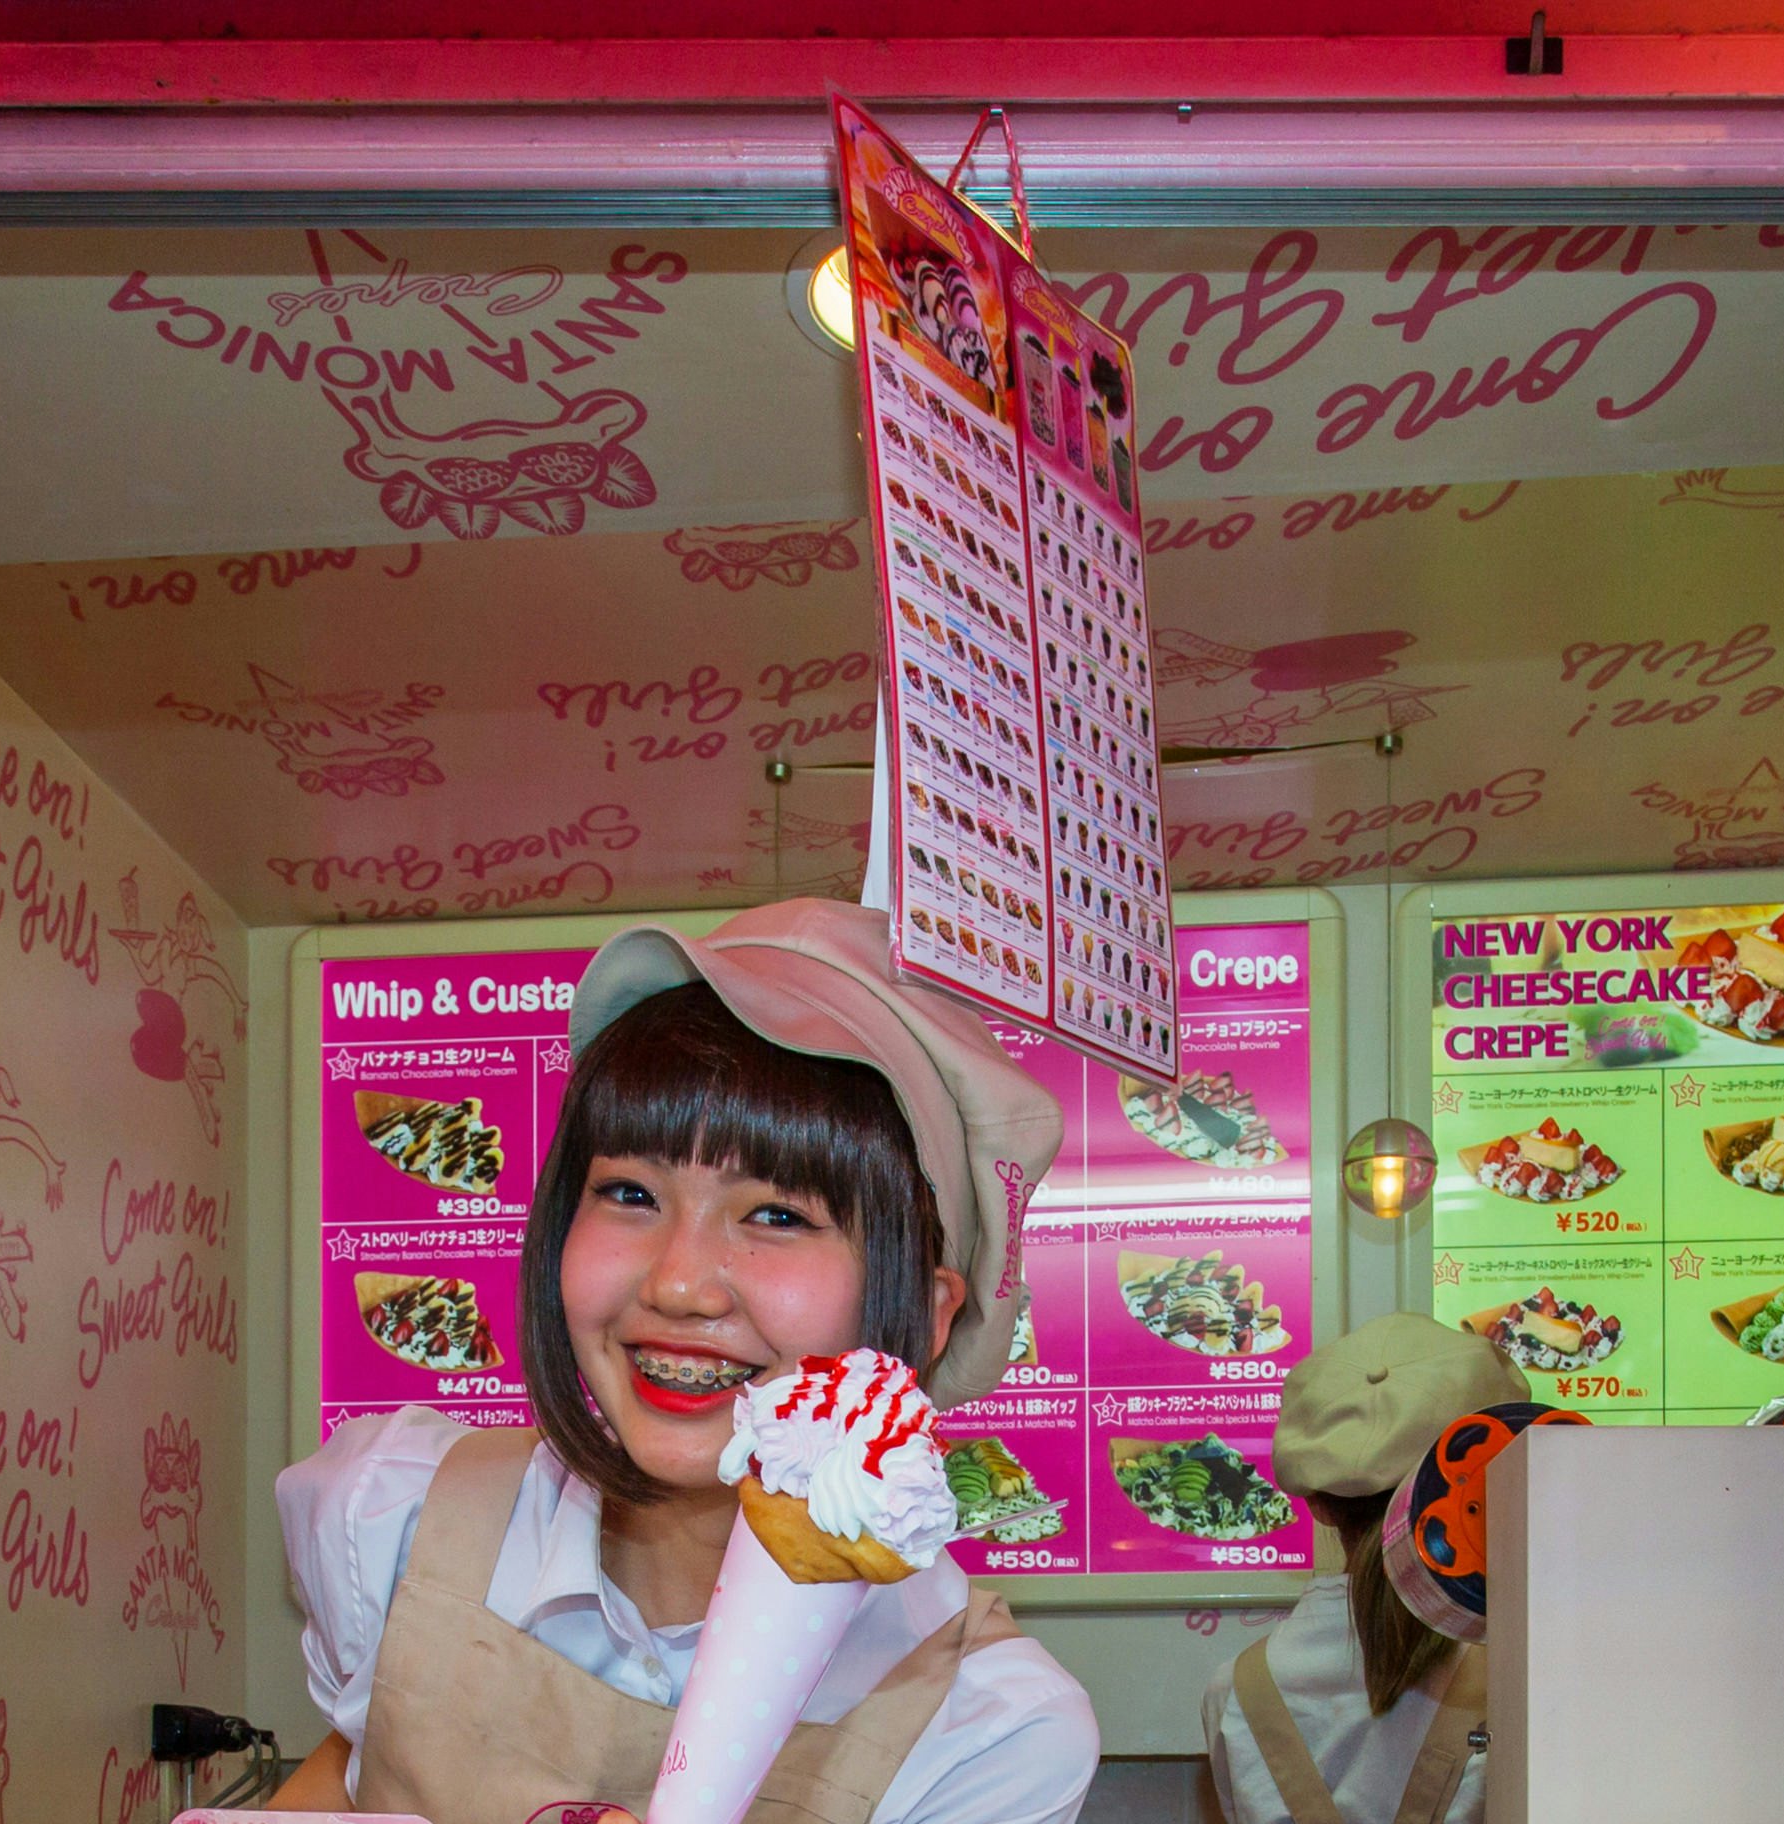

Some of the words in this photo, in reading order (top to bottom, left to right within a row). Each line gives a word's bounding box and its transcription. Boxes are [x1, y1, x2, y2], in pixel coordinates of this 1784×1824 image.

[466, 243, 687, 383] SANTA
[109, 271, 455, 392] MONICA
[1317, 281, 1717, 454] Come
[29, 761, 91, 850] on!
[1327, 768, 1545, 832] Sweet
[453, 805, 640, 874] Sweet
[15, 835, 99, 985] Girls
[1444, 922, 1544, 958] NEW
[1556, 916, 1673, 953] YORK
[1191, 950, 1298, 989] Crepe
[1443, 967, 1712, 1009] CHEESECAKE
[333, 980, 422, 1021] Whip
[432, 978, 459, 1015] &
[1182, 1042, 1237, 1053] Chocolate
[1240, 1040, 1280, 1051] Brownie
[1444, 1024, 1570, 1060] CREPE
[334, 1059, 352, 1072] 30
[361, 1047, 515, 1067] バナナチョコ生クリーム
[549, 1052, 564, 1065] 29
[361, 1070, 399, 1080] Banana
[402, 1068, 454, 1079] Chocolate
[456, 1067, 481, 1078] Whip
[483, 1066, 517, 1076] Cream
[1439, 1094, 1454, 1106] S8
[1680, 1086, 1695, 1099] S9
[101, 1158, 176, 1265] Come
[182, 1185, 230, 1250] on!
[438, 1198, 501, 1216] ¥390
[1556, 1211, 1619, 1232] ¥520
[361, 1229, 525, 1247] ストロベリーバナナチョコ生クリーム
[1042, 1234, 1073, 1245] Cream
[1126, 1231, 1173, 1242] Strawberry
[1176, 1231, 1213, 1241] Banana
[1215, 1229, 1263, 1239] Chocolate
[1264, 1227, 1298, 1239] Special
[336, 1240, 351, 1253] 13
[360, 1251, 400, 1261] Strawberry
[402, 1250, 432, 1260] Banana
[434, 1249, 475, 1259] Chocolate
[477, 1249, 495, 1258] Whip
[78, 1260, 165, 1389] Sweet
[171, 1252, 237, 1365] Girls
[1210, 1361, 1276, 1379] ¥580
[438, 1377, 501, 1395] ¥470
[1557, 1377, 1620, 1398] ¥570
[1102, 1404, 1117, 1418] 87
[987, 1420, 1020, 1430] Special
[1057, 1419, 1077, 1429] Whip
[16, 1407, 79, 1478] on!
[2, 1489, 88, 1612] Girls
[986, 1550, 1053, 1568] ¥530
[1211, 1546, 1277, 1564] ¥530
[123, 1545, 170, 1631] SANTA
[172, 1542, 224, 1653] MONICA
